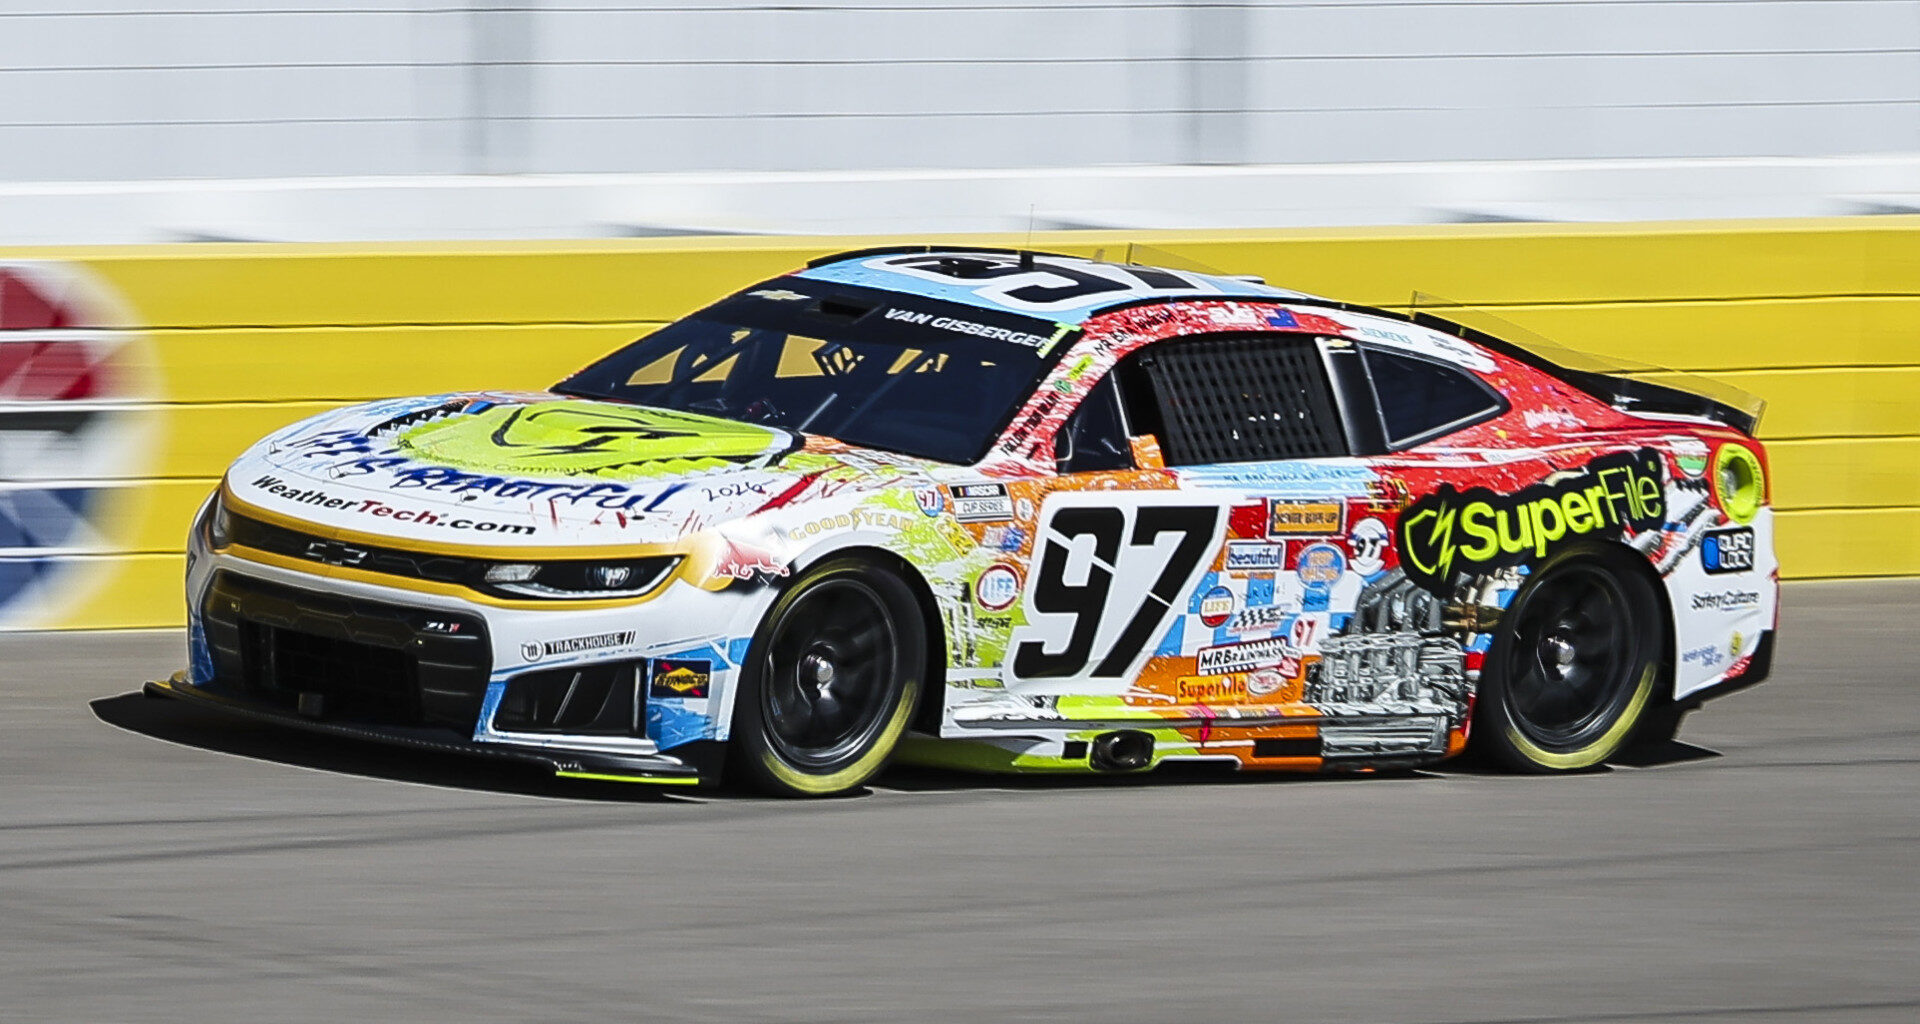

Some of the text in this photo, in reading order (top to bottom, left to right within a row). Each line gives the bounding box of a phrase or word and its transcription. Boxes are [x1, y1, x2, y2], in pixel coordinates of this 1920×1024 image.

[885, 308, 930, 325] VAN
[701, 481, 768, 502] 2026
[251, 475, 537, 535] WeatherTech.com
[788, 507, 914, 541] GOODYEAR
[1230, 548, 1281, 565] beautiful
[1013, 506, 1219, 679] 97
[1204, 599, 1230, 613] LIFE
[548, 633, 621, 654] TRACKHOUSE
[1293, 620, 1316, 647] 97
